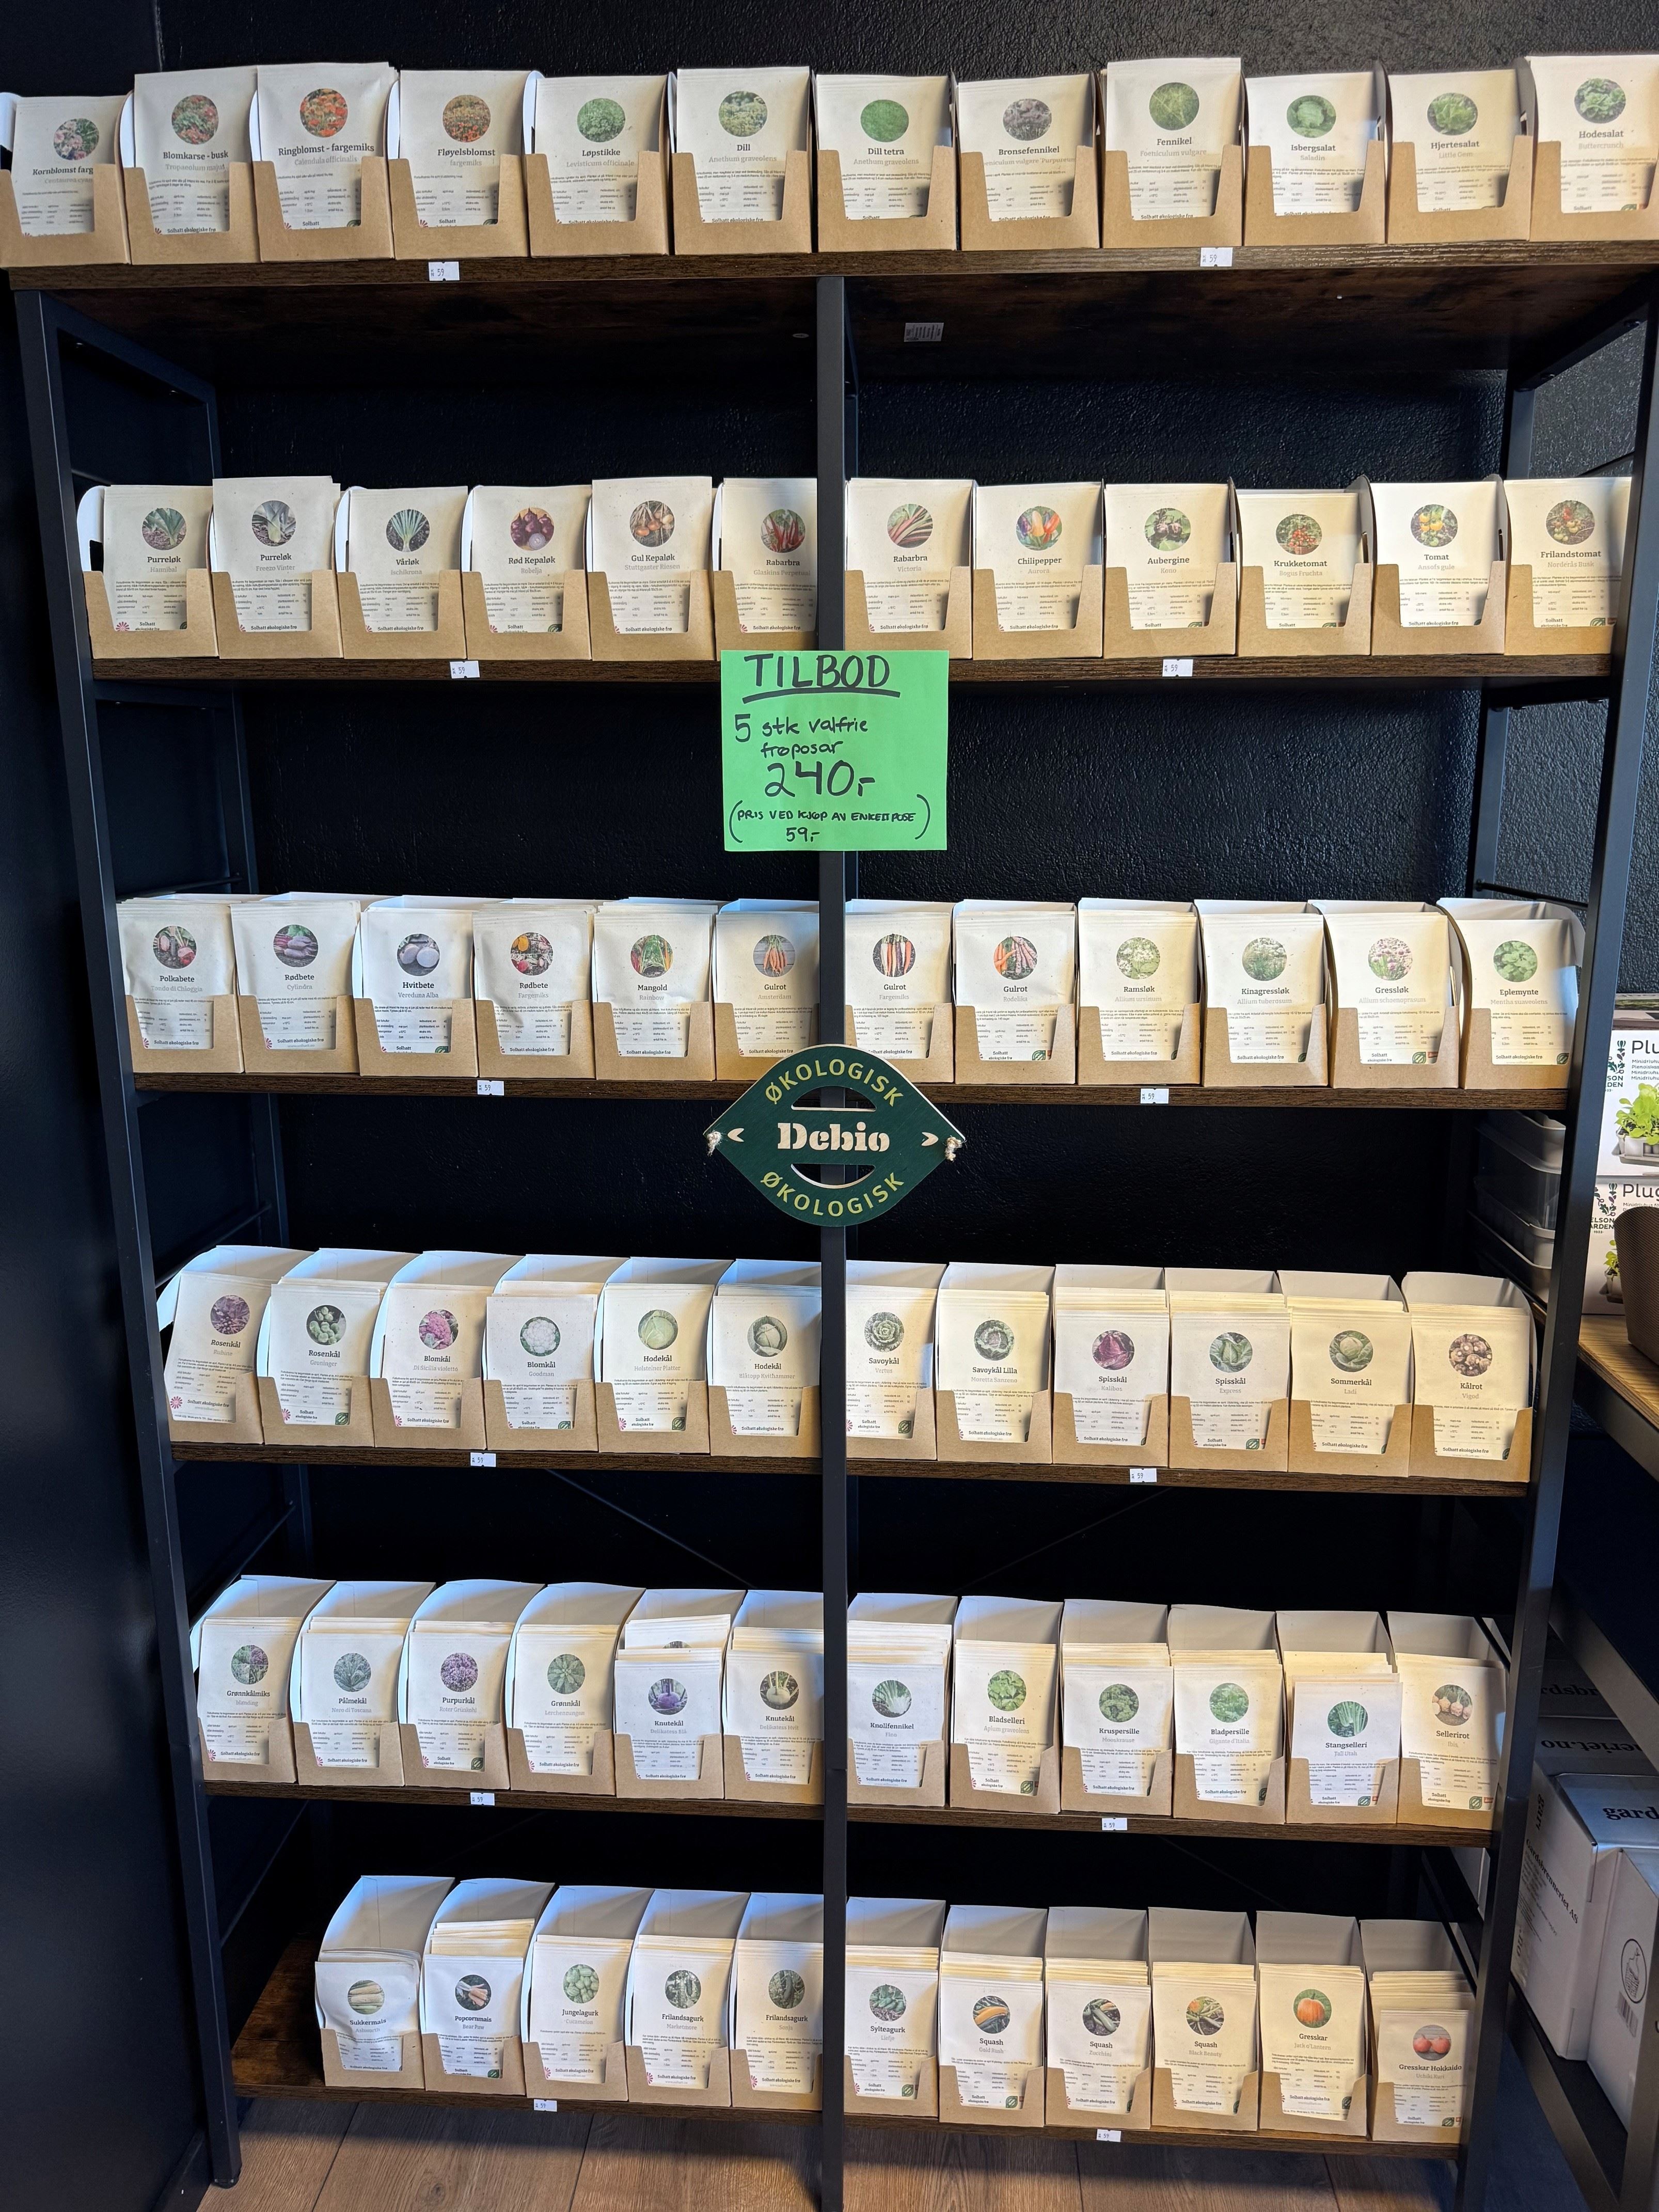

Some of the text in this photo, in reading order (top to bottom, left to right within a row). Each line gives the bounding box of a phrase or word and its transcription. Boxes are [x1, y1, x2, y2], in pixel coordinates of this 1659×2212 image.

[1578, 129, 1624, 139] Hodesalat
[1157, 137, 1192, 146] Fennikel
[1431, 140, 1480, 151] Hjertesalat
[278, 145, 325, 157] Ringblomst
[331, 143, 374, 153] fargemiks
[437, 148, 495, 157] Fløyelsblomst
[582, 148, 621, 158] Løpstikke
[999, 146, 1060, 155] Bronsefennikel
[1291, 144, 1336, 153] Isbergsalat
[163, 151, 206, 160] Blomkarse
[211, 150, 229, 160] busk
[33, 166, 93, 176] Kornblomst farg
[1209, 254, 1218, 263] 59
[437, 268, 445, 277] 59
[260, 553, 292, 561] Purreløk
[524, 556, 556, 565] Kepaløk
[645, 554, 675, 563] Kepaløk
[893, 554, 928, 562] Rabarbra
[1017, 557, 1062, 566] Chilipepper
[1147, 556, 1190, 565] Aubergine
[744, 653, 890, 688] TILBOD
[735, 713, 868, 742] 5 stk valfrie
[769, 810, 794, 820] VED
[831, 812, 846, 821] AV
[638, 984, 668, 992] Mangold
[1241, 987, 1290, 996] Kinagressløk
[1499, 988, 1539, 997] Eplemynte
[765, 1058, 904, 1107] ØKOLOGISK
[777, 1121, 890, 1152] Debio
[760, 1171, 904, 1217] ØKOLOGISK
[211, 1339, 241, 1348] Rosenkål
[308, 1350, 340, 1358] Rosenkål
[868, 1357, 899, 1366] Savoykål
[972, 1366, 1002, 1375] Savoykål
[1215, 1377, 1246, 1386] Spisskål
[442, 1697, 475, 1705] Purpurkål
[989, 1715, 1025, 1725] Bladselleri
[1211, 1728, 1250, 1736] Bladpersille
[1436, 1730, 1470, 1739] Sellerirot
[561, 2009, 598, 2018] Jungelagurk
[662, 2013, 704, 2023] Frilandsagurk
[766, 2014, 808, 2023] Frilandsagurk
[870, 2026, 906, 2034] Sylteagurk
[979, 2037, 1004, 2046] Squash
[1194, 2041, 1218, 2049] Squash
